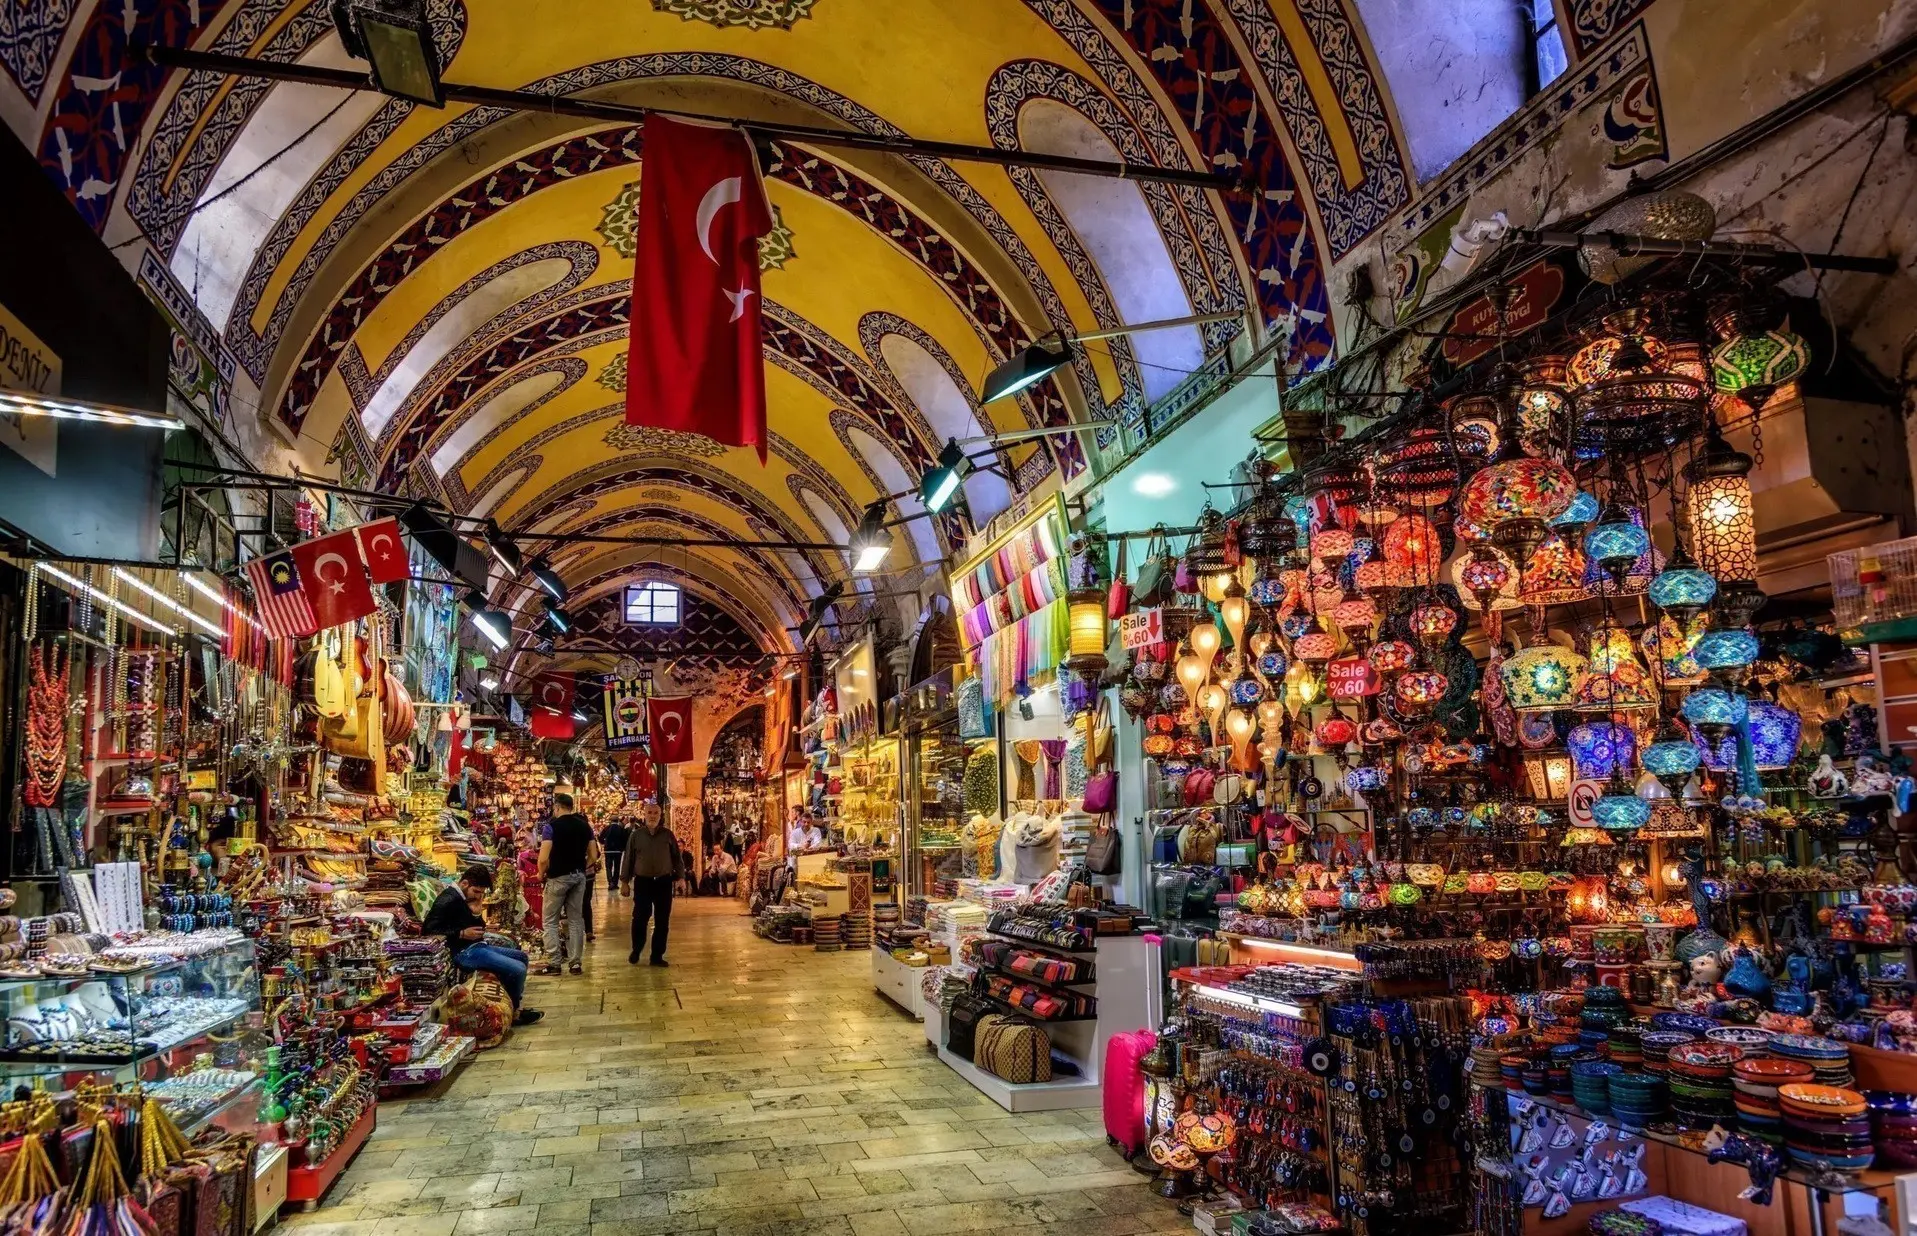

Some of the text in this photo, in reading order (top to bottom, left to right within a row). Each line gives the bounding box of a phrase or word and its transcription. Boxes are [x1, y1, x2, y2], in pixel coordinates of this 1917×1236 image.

[1122, 615, 1147, 631] Sale
[1123, 630, 1149, 648] %60
[1330, 663, 1365, 678] Sale
[1329, 680, 1365, 696] %60
[608, 734, 650, 747] FENERBAHÇ
